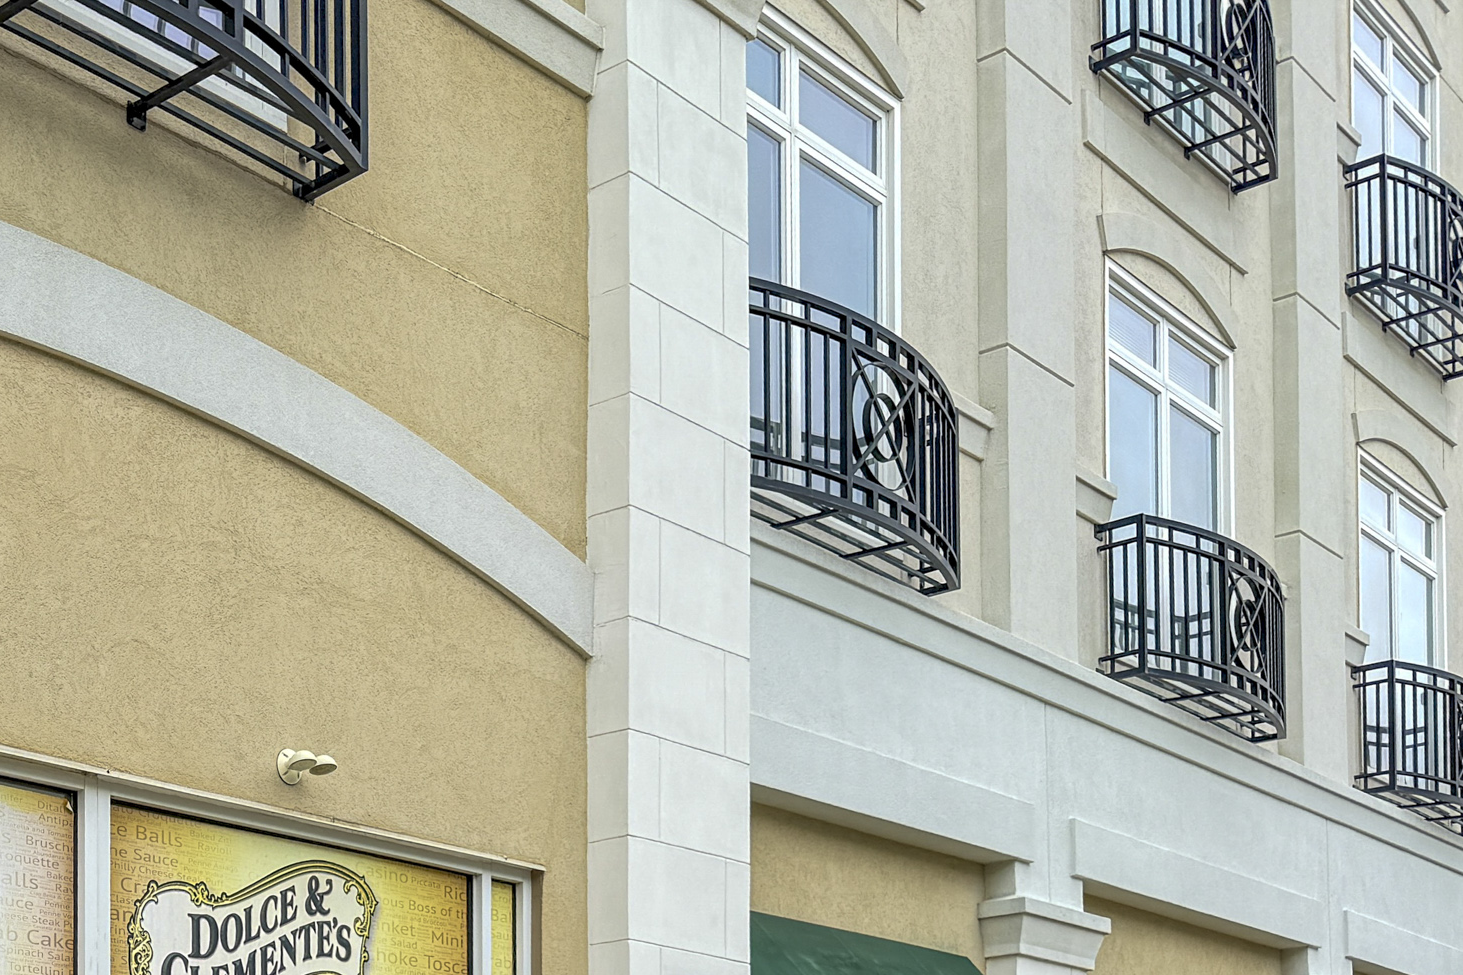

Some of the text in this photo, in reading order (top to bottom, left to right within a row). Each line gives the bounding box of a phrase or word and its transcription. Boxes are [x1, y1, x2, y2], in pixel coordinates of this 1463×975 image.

[136, 824, 183, 848] Balls
[198, 841, 233, 856] Ravioli
[133, 848, 179, 868] Sauce
[138, 865, 174, 879] Cheese
[410, 876, 441, 890] Piccata
[408, 899, 452, 917] Boss of
[31, 914, 61, 928] Steak
[188, 875, 333, 959] DOLCE &
[431, 930, 464, 949] Mini
[0, 944, 44, 959] Spinach
